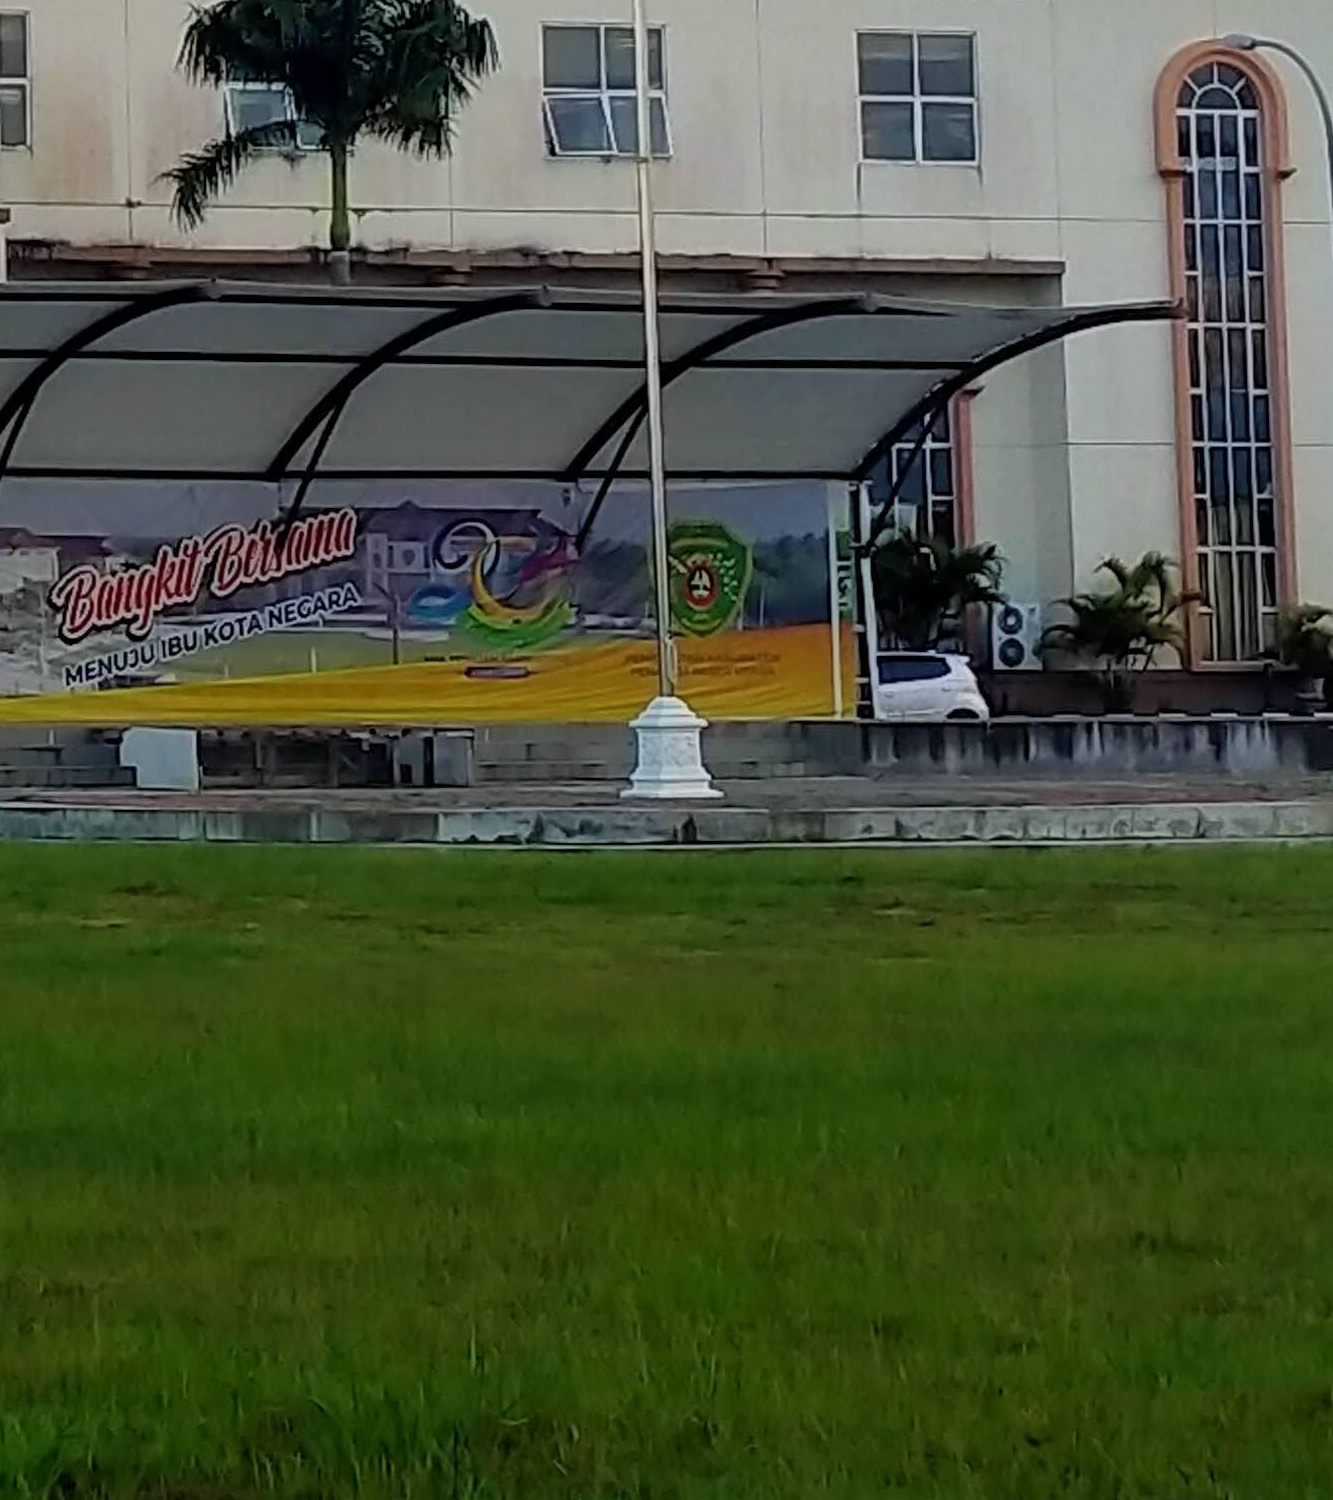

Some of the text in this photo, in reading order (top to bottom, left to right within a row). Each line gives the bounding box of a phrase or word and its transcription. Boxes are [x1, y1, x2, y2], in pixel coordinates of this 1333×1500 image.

[52, 508, 358, 638] Bangkit Bersama
[64, 582, 360, 687] MENUJU IBU KOTA NEGARA
